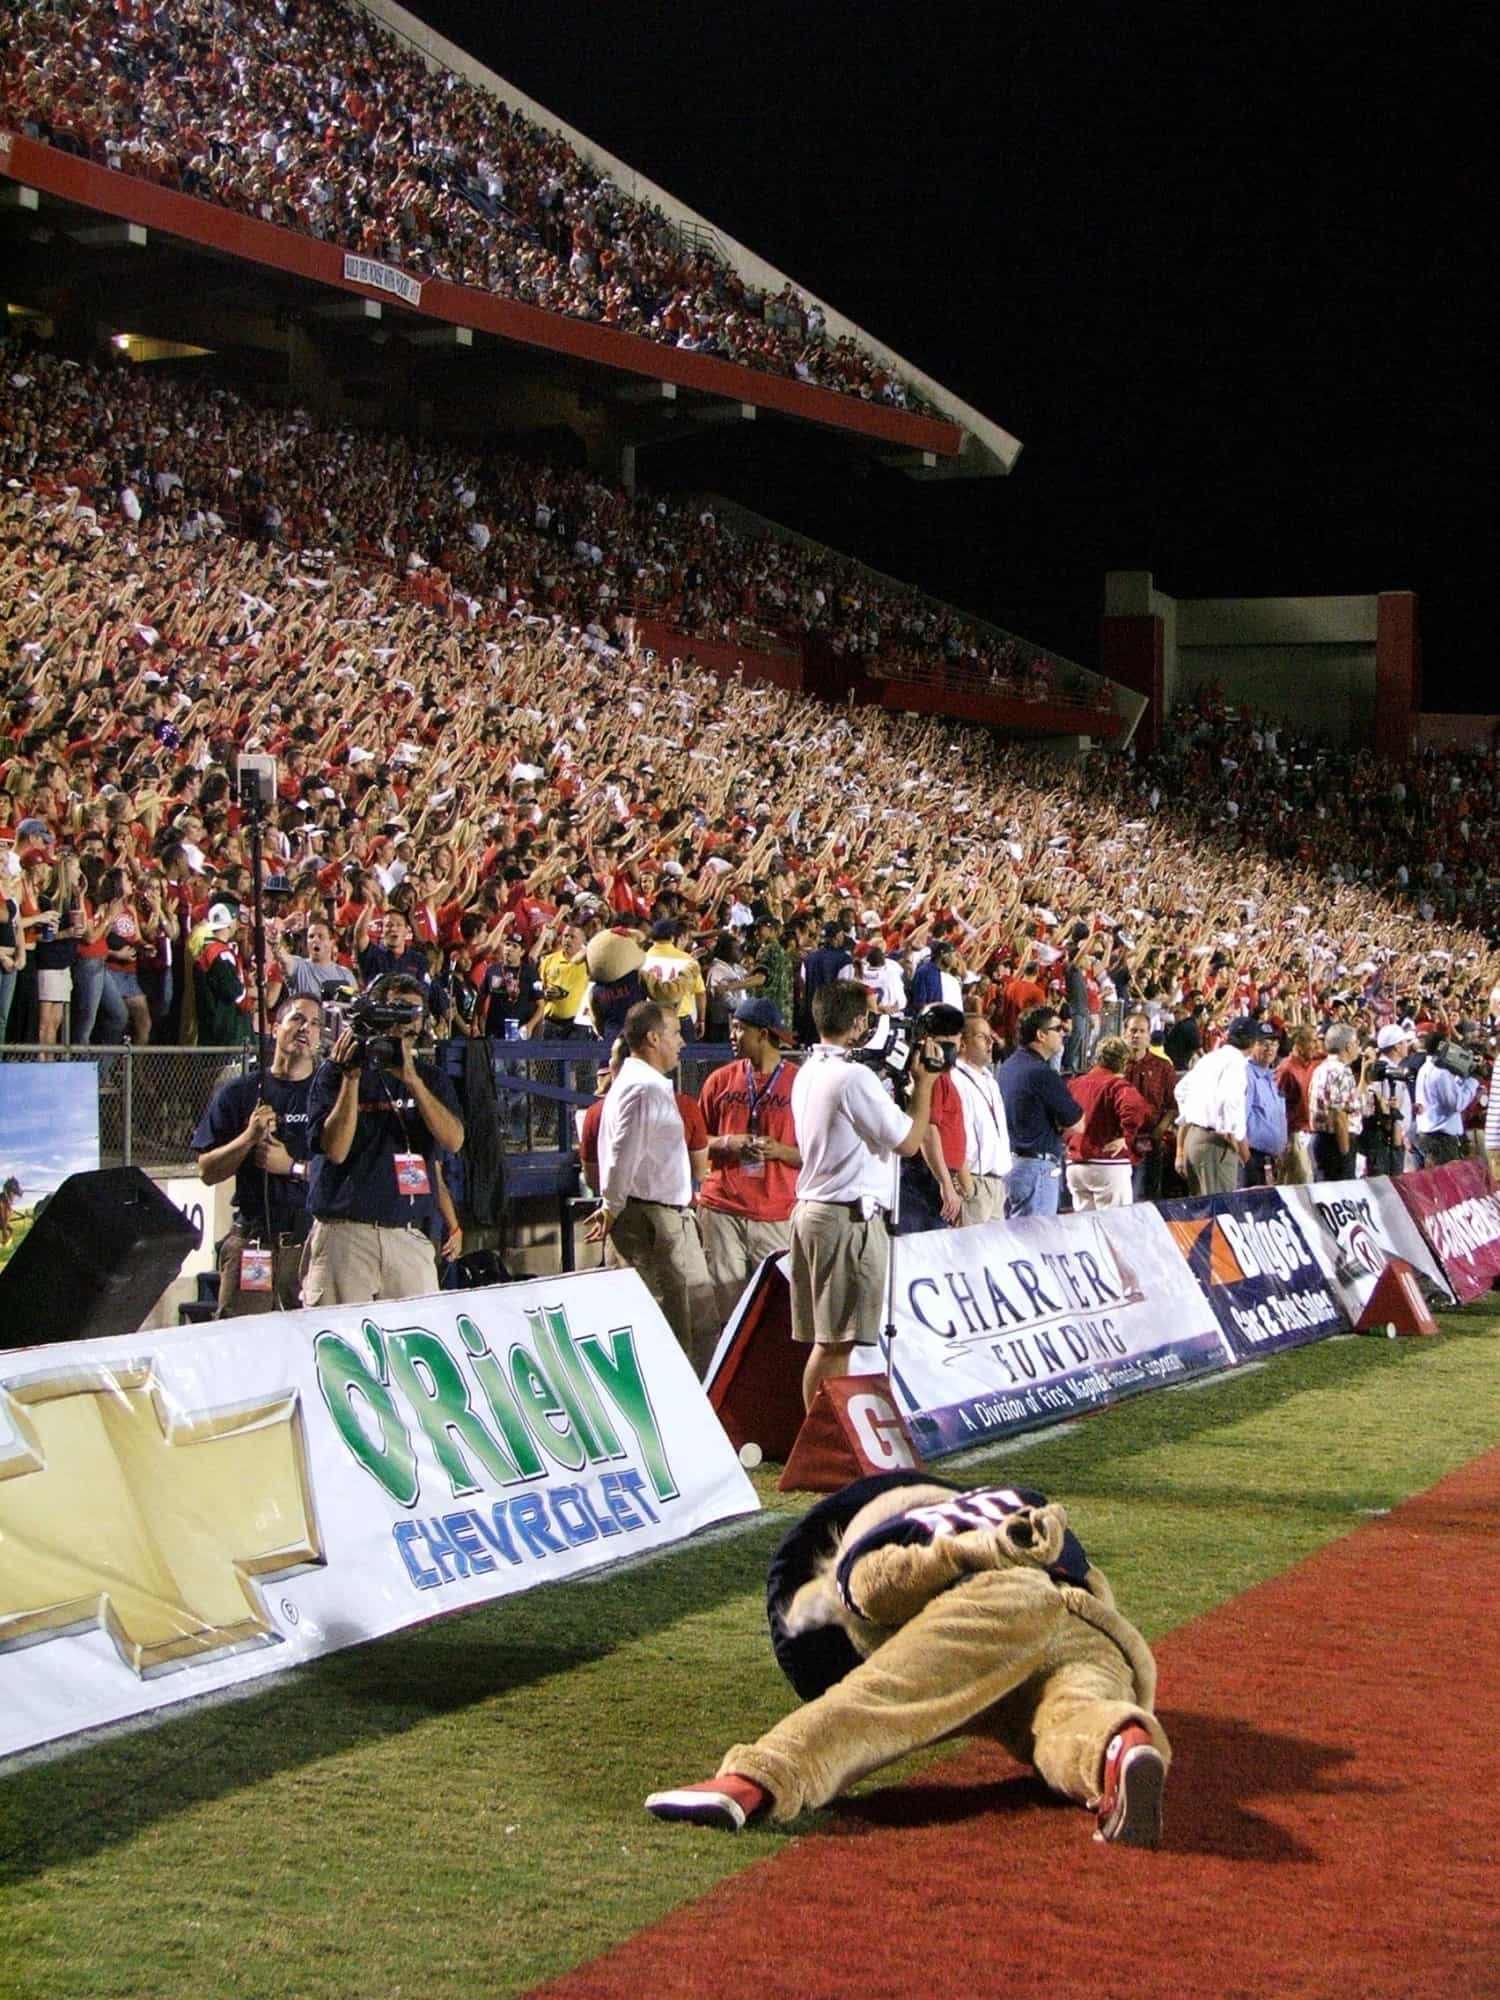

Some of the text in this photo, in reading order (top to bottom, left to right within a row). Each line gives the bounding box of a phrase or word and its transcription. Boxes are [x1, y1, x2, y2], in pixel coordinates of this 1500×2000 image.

[908, 1251, 1120, 1338] CHARTER
[1257, 1304, 1282, 1336] &
[313, 1303, 681, 1508] O'Rielly
[848, 1393, 915, 1470] G
[959, 1407, 977, 1431] A
[974, 1390, 1024, 1429] Division
[1025, 1388, 1041, 1413] of
[1037, 1384, 1074, 1409] First
[393, 1467, 661, 1590] CHEVROLET
